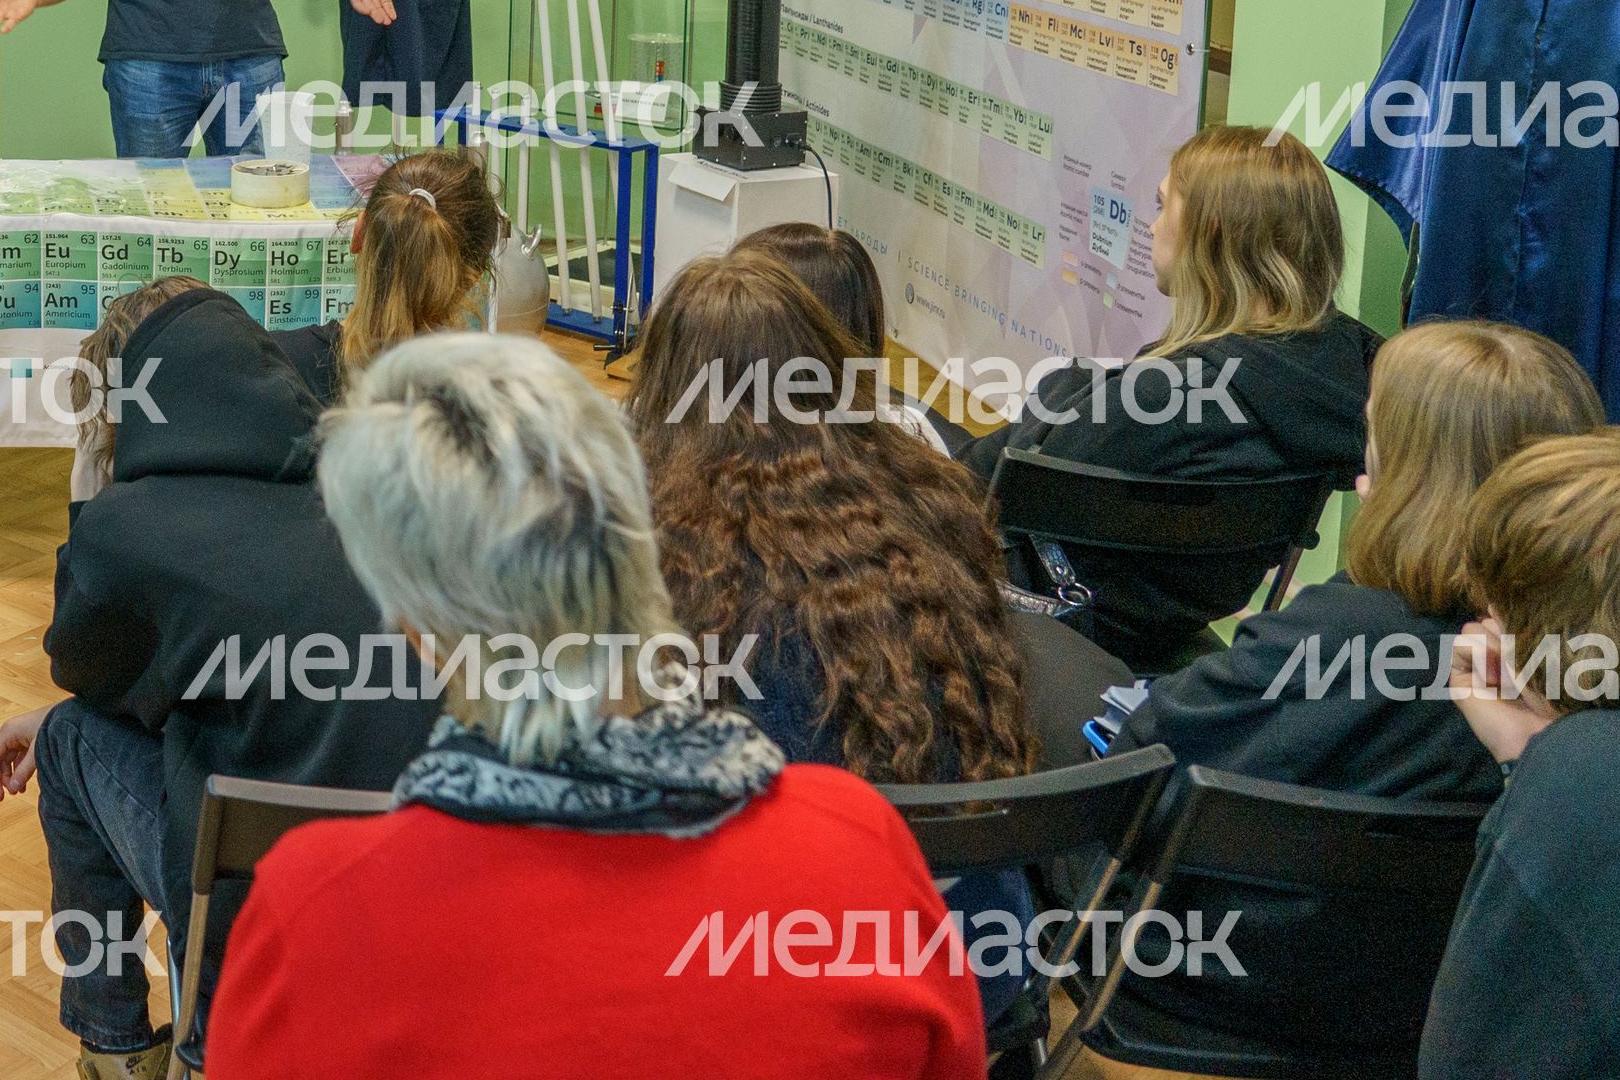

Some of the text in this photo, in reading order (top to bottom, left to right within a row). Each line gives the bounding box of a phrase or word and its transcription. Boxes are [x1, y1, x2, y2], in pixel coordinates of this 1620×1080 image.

[1099, 32, 1111, 47] Lv
[1129, 40, 1142, 56] Ts
[1161, 49, 1173, 70] Og
[1110, 200, 1127, 224] Db
[24, 234, 39, 243] 62
[81, 235, 95, 244] 63
[137, 237, 151, 247] 64
[194, 240, 208, 250] 65
[251, 242, 265, 251] 66
[307, 241, 321, 250] 67
[46, 243, 70, 258] Eu
[102, 244, 128, 260] Gd
[158, 248, 183, 263] Tb
[215, 251, 241, 269] Dy
[272, 251, 299, 266] Ho
[328, 250, 349, 264] Er
[46, 261, 86, 270] Europium
[158, 265, 192, 273] Terbium
[215, 268, 263, 276] Dysprosium
[25, 284, 39, 293] 94
[81, 285, 95, 294] 95
[249, 291, 263, 300] 98
[305, 289, 319, 299] 99
[45, 293, 78, 308] Am
[270, 300, 291, 314] Es
[908, 256, 1067, 357] SCIENCE BRINGING NATIONS
[46, 310, 90, 319] Americium
[270, 316, 317, 324] Einsteinium
